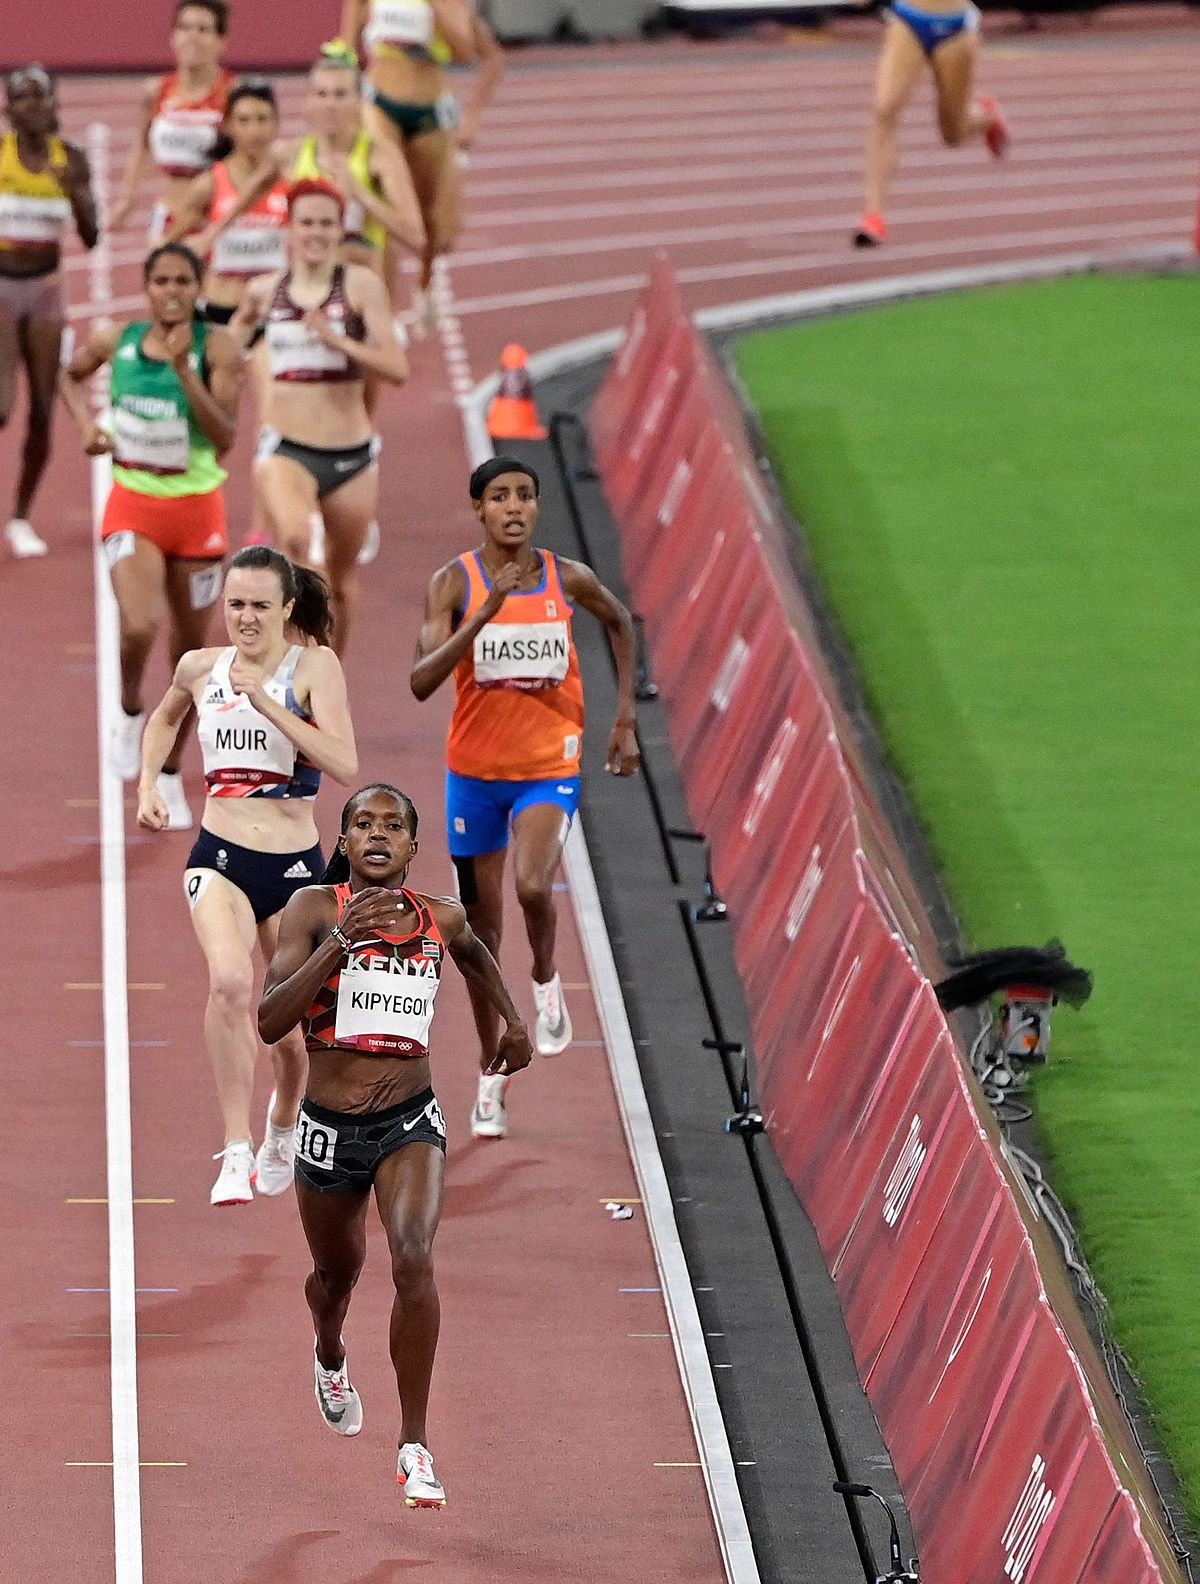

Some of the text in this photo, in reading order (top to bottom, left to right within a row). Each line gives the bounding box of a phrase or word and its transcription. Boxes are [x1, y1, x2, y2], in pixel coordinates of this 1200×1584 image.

[482, 639, 566, 660] HASSAN
[216, 729, 267, 751] MUIR
[347, 953, 437, 979] KENYA
[300, 1120, 329, 1163] 10
